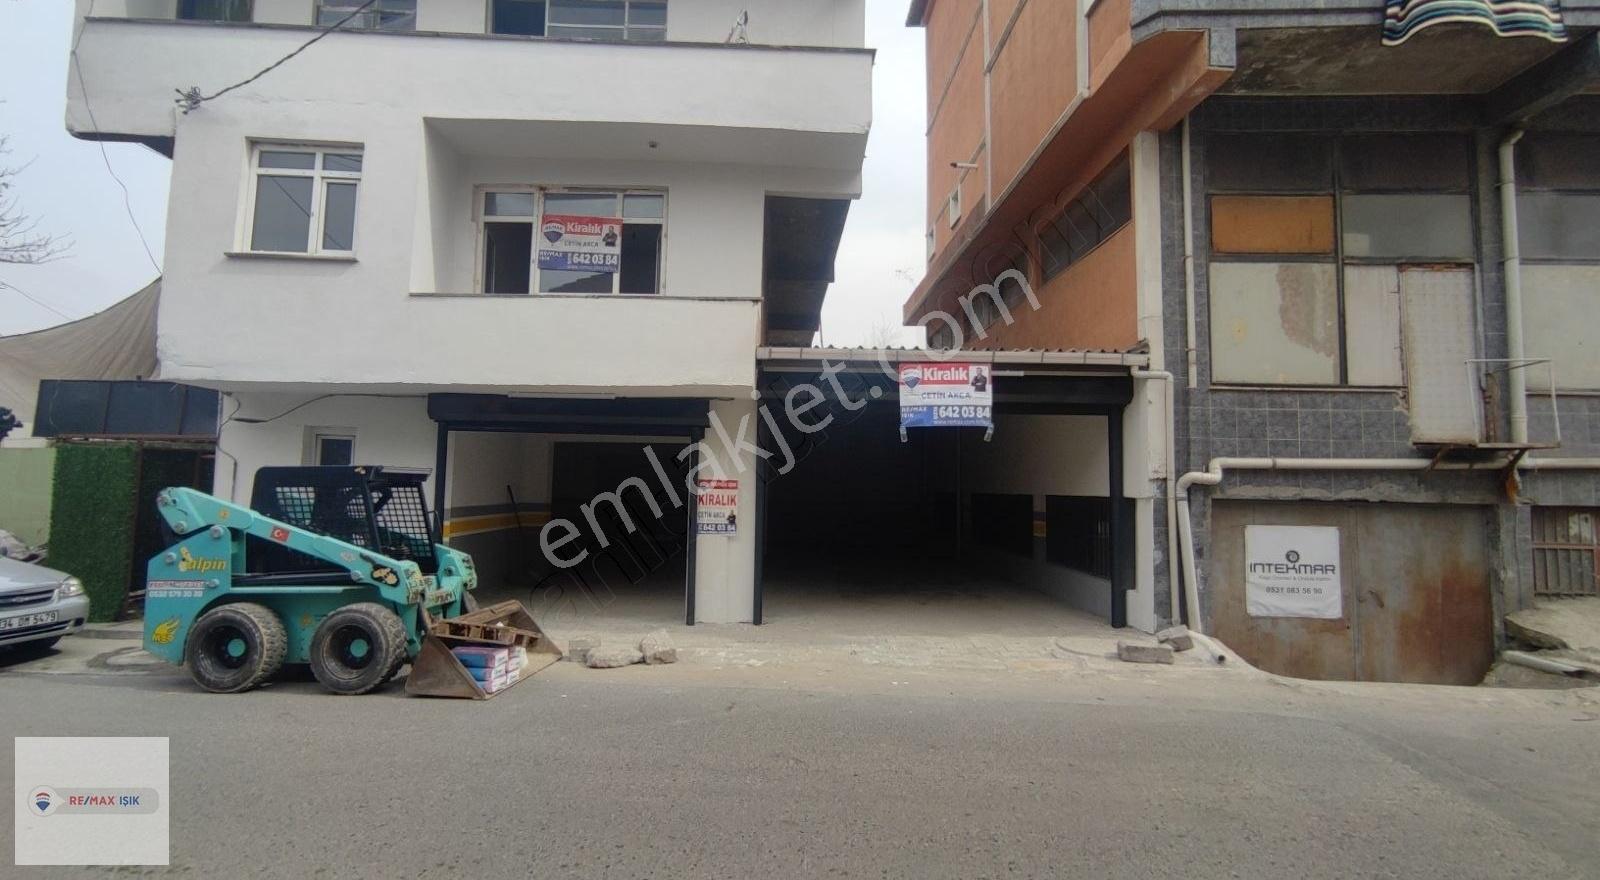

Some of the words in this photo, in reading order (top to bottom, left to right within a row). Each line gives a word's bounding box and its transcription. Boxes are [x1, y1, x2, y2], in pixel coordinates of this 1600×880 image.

[566, 221, 602, 234] Kiralık
[573, 253, 591, 264] 642
[591, 254, 604, 265] 03
[605, 255, 618, 265] 84
[923, 367, 968, 381] Kiralık
[939, 406, 960, 418] 642
[961, 406, 975, 418] 03
[976, 406, 990, 418] 84
[703, 523, 715, 531] 642
[1249, 562, 1336, 575] INTEKMAR
